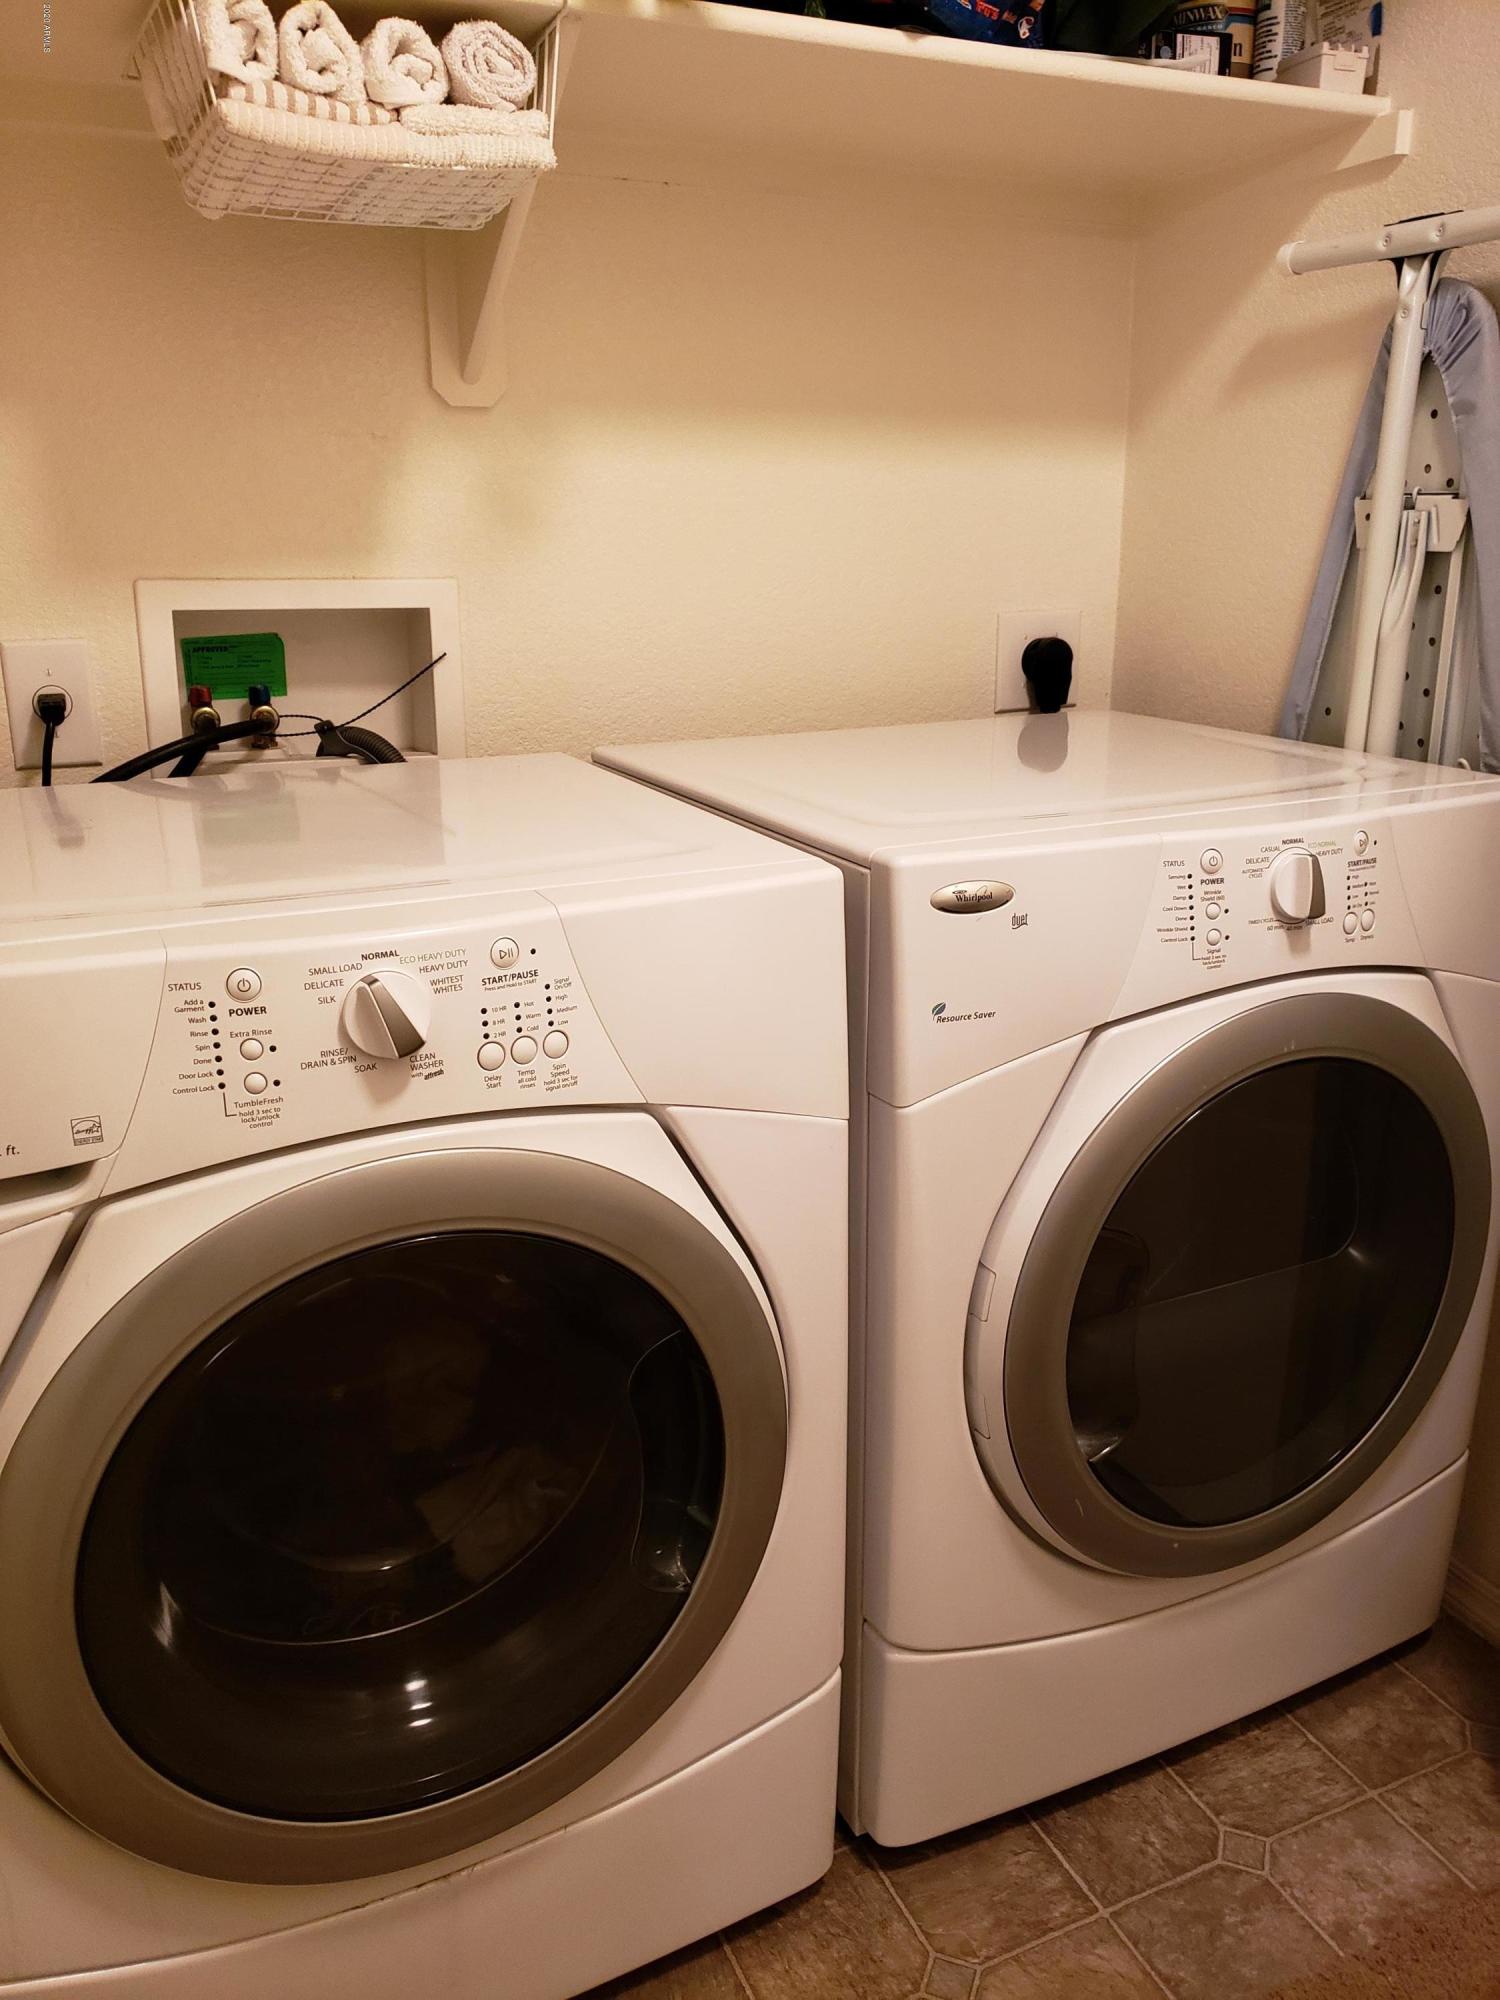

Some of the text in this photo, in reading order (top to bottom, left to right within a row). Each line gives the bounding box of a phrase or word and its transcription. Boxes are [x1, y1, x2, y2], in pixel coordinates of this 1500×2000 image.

[1245, 857, 1270, 865] DELICATE
[955, 892, 993, 903] Whirlpool
[1011, 913, 1028, 928] duet
[361, 950, 400, 961] NORMAL
[400, 948, 467, 965] ECO HEAVY DUTY
[308, 962, 363, 976] SMALL LOAD
[419, 960, 468, 974] HEAVY DUTY
[429, 975, 464, 987] WHITEST
[481, 969, 539, 986] START/PAUSE
[554, 976, 570, 985] Signal
[167, 982, 202, 992] STATUS
[304, 979, 345, 991] DELICATE
[433, 984, 463, 995] WHITES
[317, 995, 336, 1005] SILK
[228, 1005, 267, 1017] POWER
[556, 1005, 578, 1013] Medium
[188, 1016, 207, 1024] Wash
[936, 1010, 996, 1024] Resource Saver
[229, 1028, 273, 1039] Extra Rinse
[195, 1044, 211, 1052] Spin
[320, 1047, 349, 1058] RINSE/
[300, 1055, 357, 1070] DRAIN & SPIN
[409, 1052, 436, 1063] CLEAN
[354, 1063, 378, 1074] SOAK
[409, 1060, 444, 1072] WASHER
[552, 1063, 567, 1071] Spin
[517, 1069, 536, 1077] Temp
[550, 1068, 570, 1078] Speed
[484, 1075, 502, 1083] Delay
[543, 1079, 556, 1087] hold
[172, 1086, 198, 1095] Control
[486, 1081, 501, 1089] Start
[545, 1080, 578, 1092] signal on/off
[234, 1096, 284, 1109] TumbleFresh
[241, 1112, 281, 1123] lock/unlock
[248, 1120, 273, 1129] control
[6, 1144, 20, 1156] ft.
